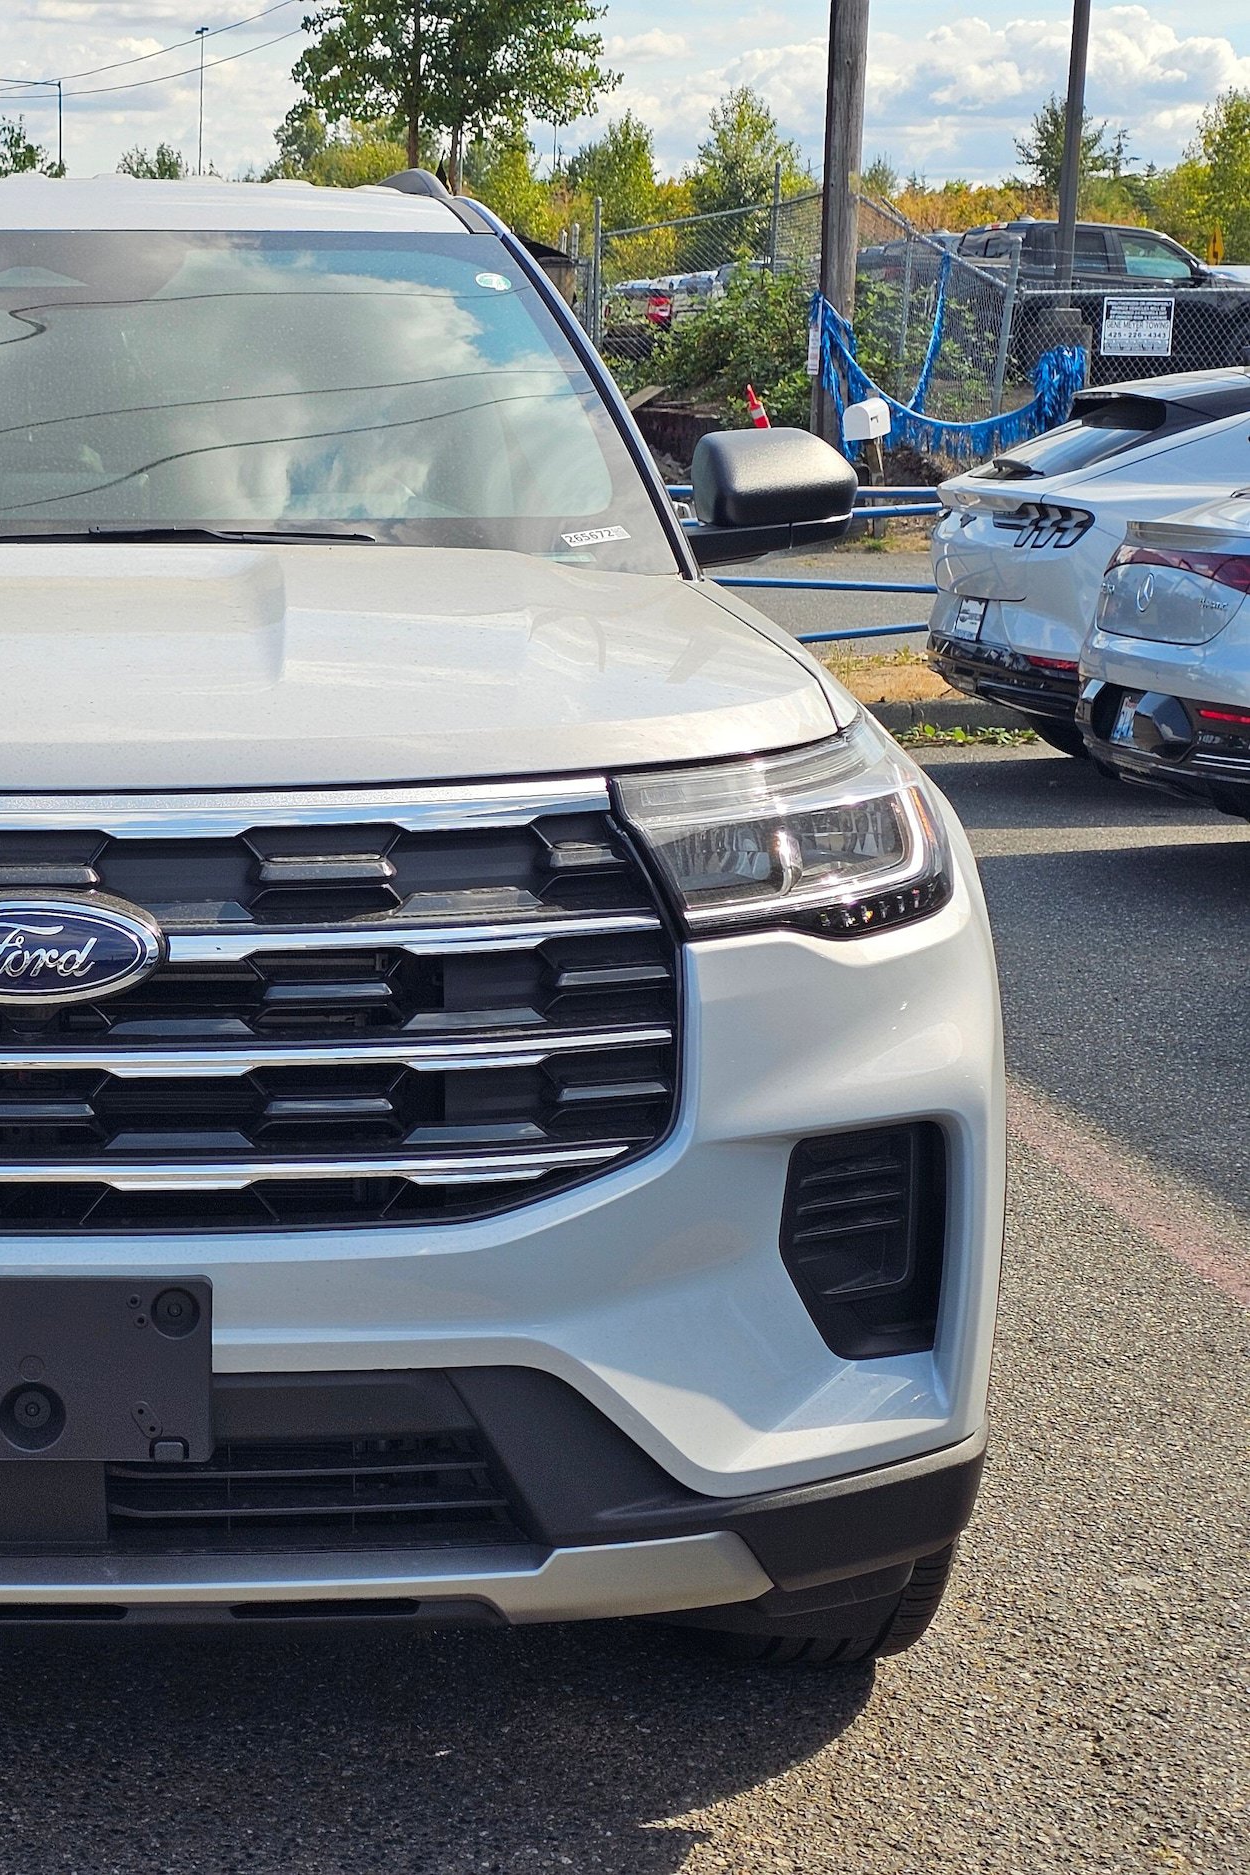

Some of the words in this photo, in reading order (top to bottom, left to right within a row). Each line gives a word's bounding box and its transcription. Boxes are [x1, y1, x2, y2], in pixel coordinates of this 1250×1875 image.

[1106, 321, 1120, 329] GENE
[1123, 321, 1144, 329] MEYER
[1146, 321, 1169, 330] TOWING
[564, 528, 616, 544] 265672
